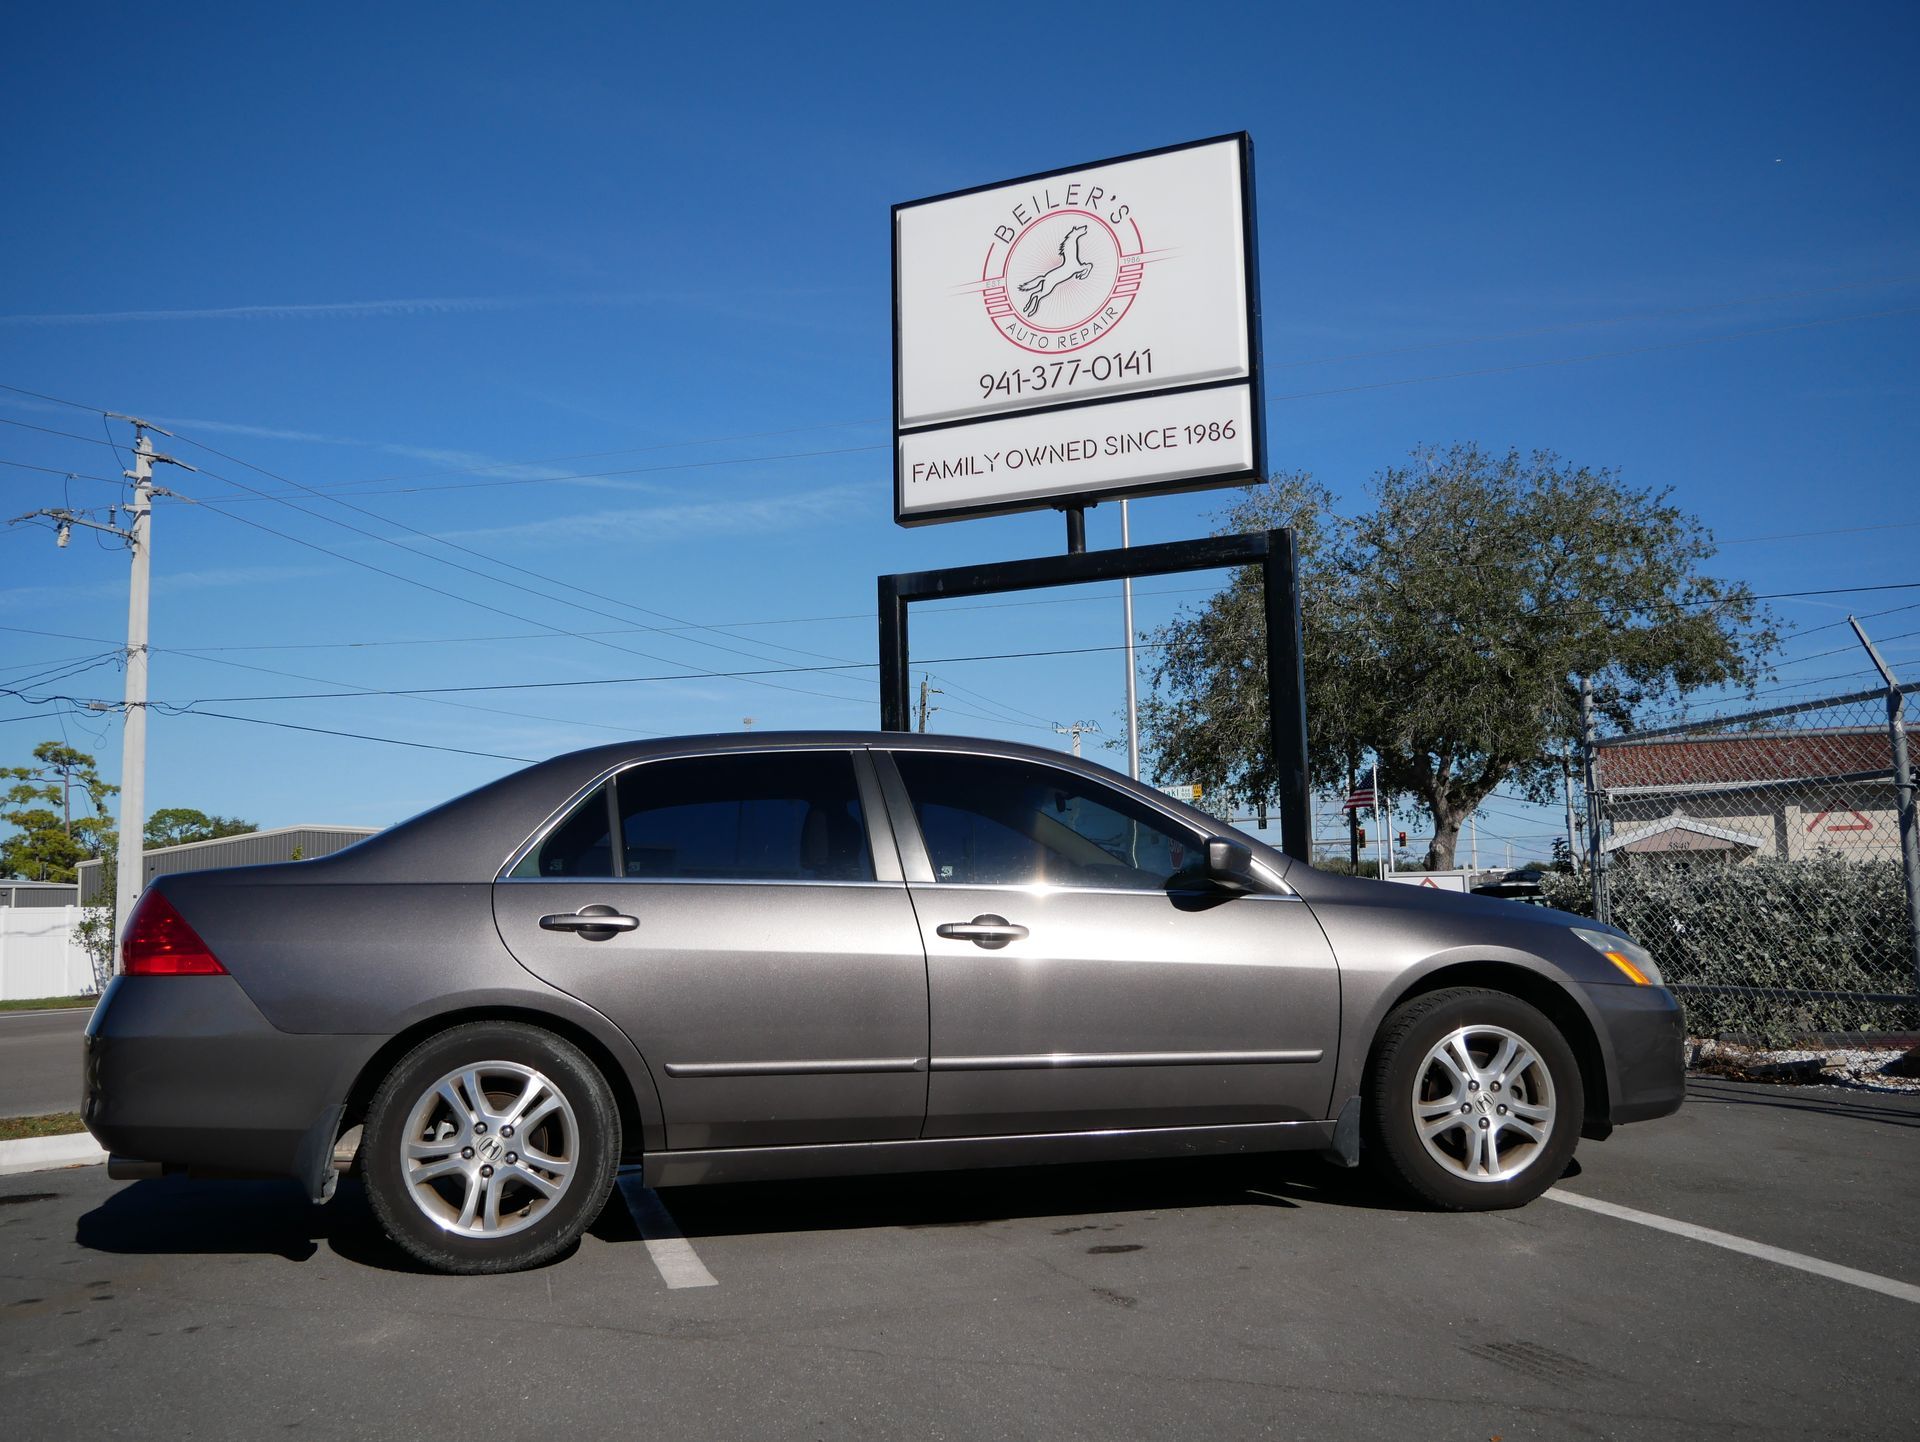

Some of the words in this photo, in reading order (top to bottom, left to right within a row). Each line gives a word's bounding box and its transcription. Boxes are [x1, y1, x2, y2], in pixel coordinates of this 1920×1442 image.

[993, 184, 1130, 244] BEILER'S
[1006, 322, 1049, 349] AUTO
[1057, 306, 1119, 349] REPAIR
[979, 348, 1152, 399] 941-377-0141
[912, 451, 1000, 483] FAMILY
[1005, 438, 1098, 470] OWNED
[1104, 426, 1178, 456] SINCE
[1184, 419, 1237, 445] 1986
